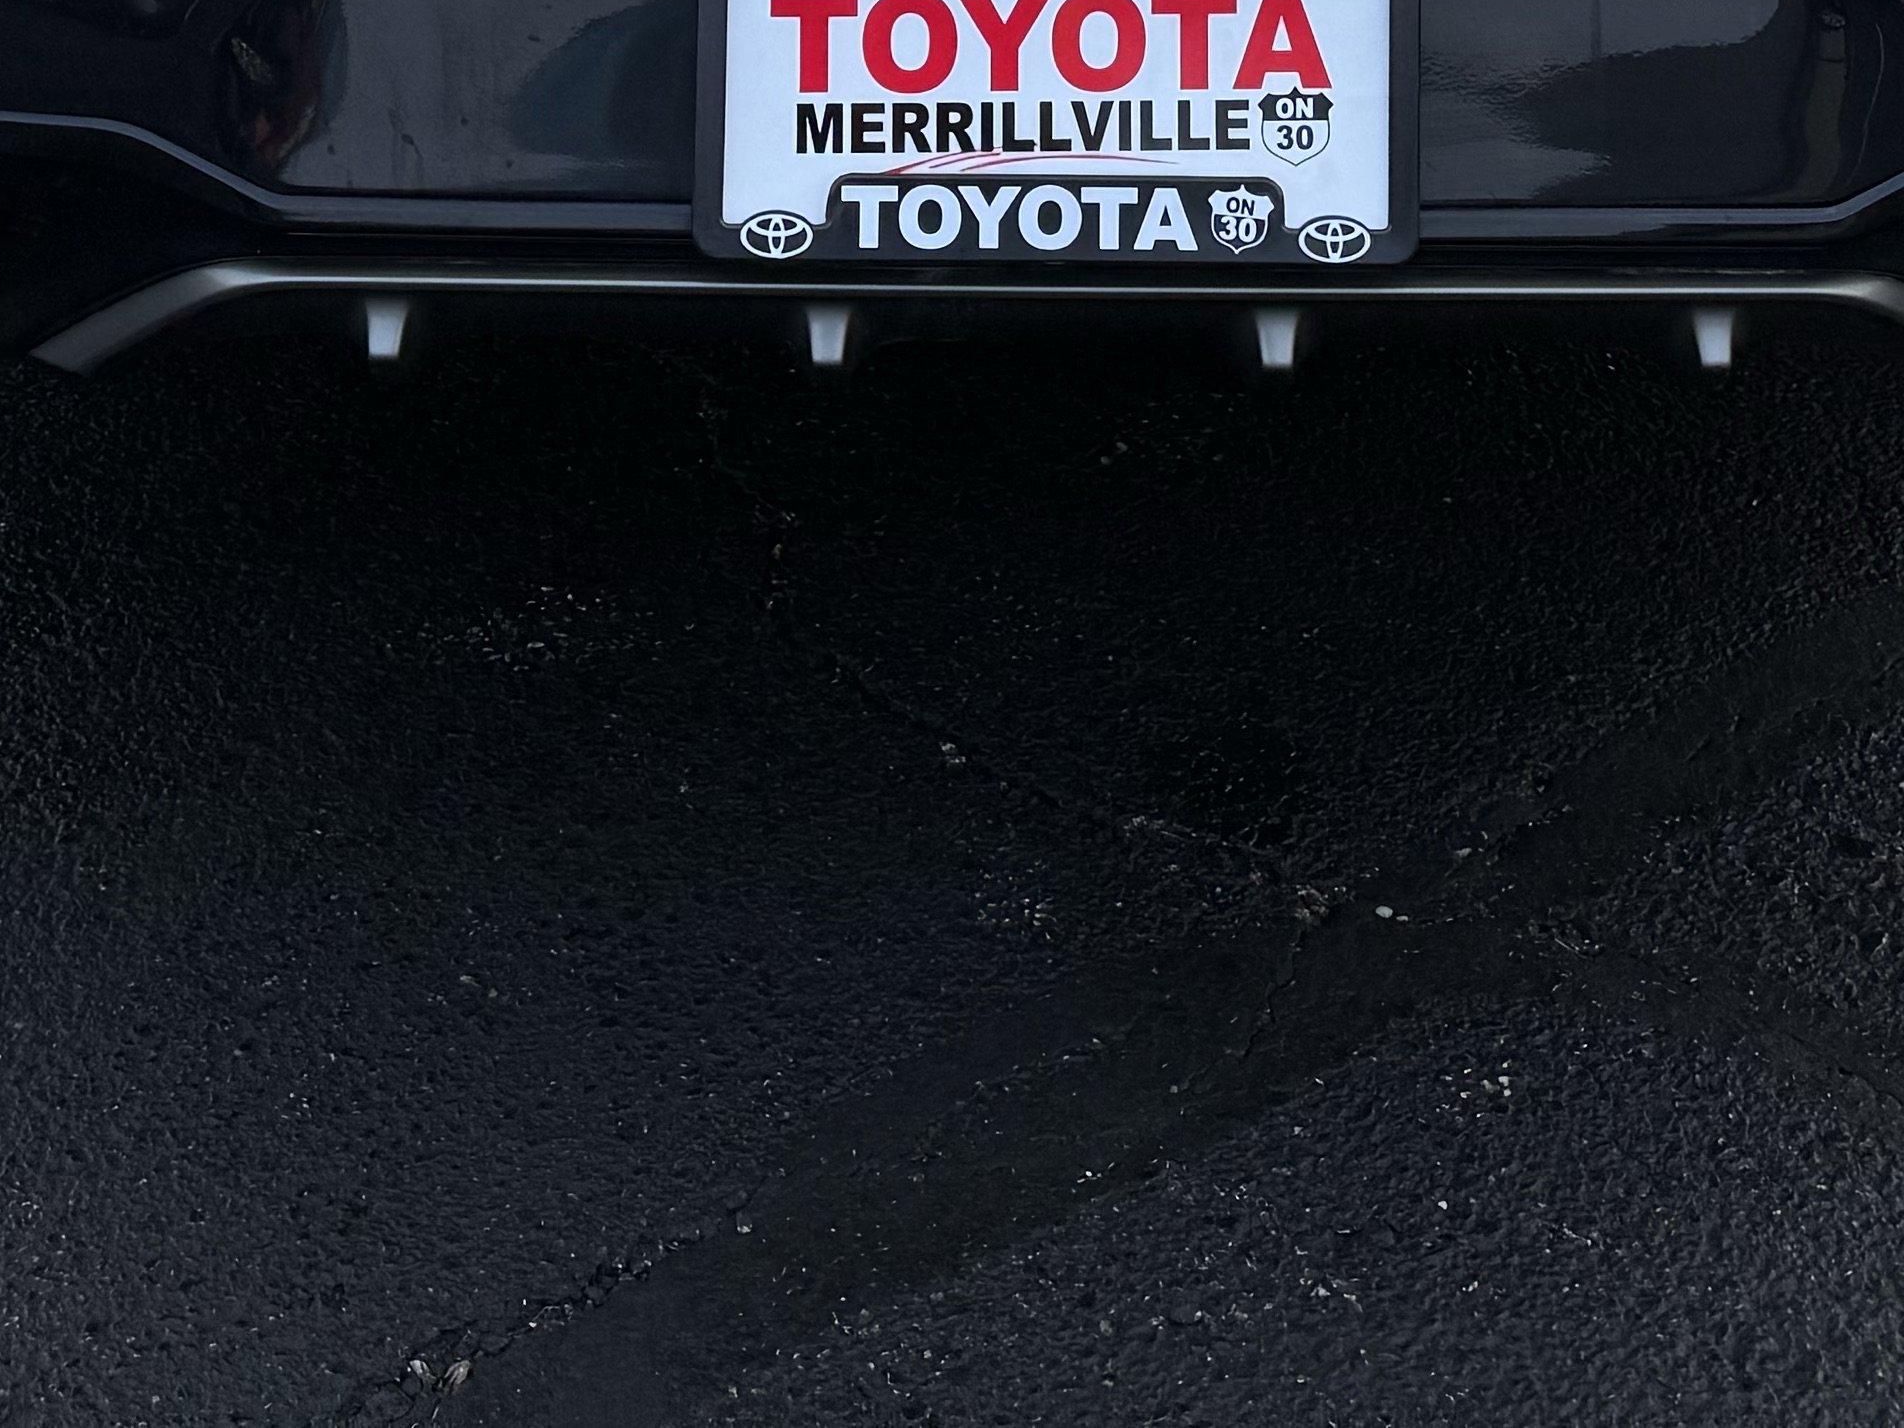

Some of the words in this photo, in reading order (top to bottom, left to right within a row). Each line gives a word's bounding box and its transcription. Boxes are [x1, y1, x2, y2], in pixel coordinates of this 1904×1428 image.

[1275, 97, 1314, 120] ON
[796, 100, 1250, 154] MERRILLVILLE
[1276, 124, 1313, 151] 30
[841, 184, 1198, 251] TOYOTA
[1225, 196, 1256, 216] ON
[1218, 216, 1258, 243] 30
